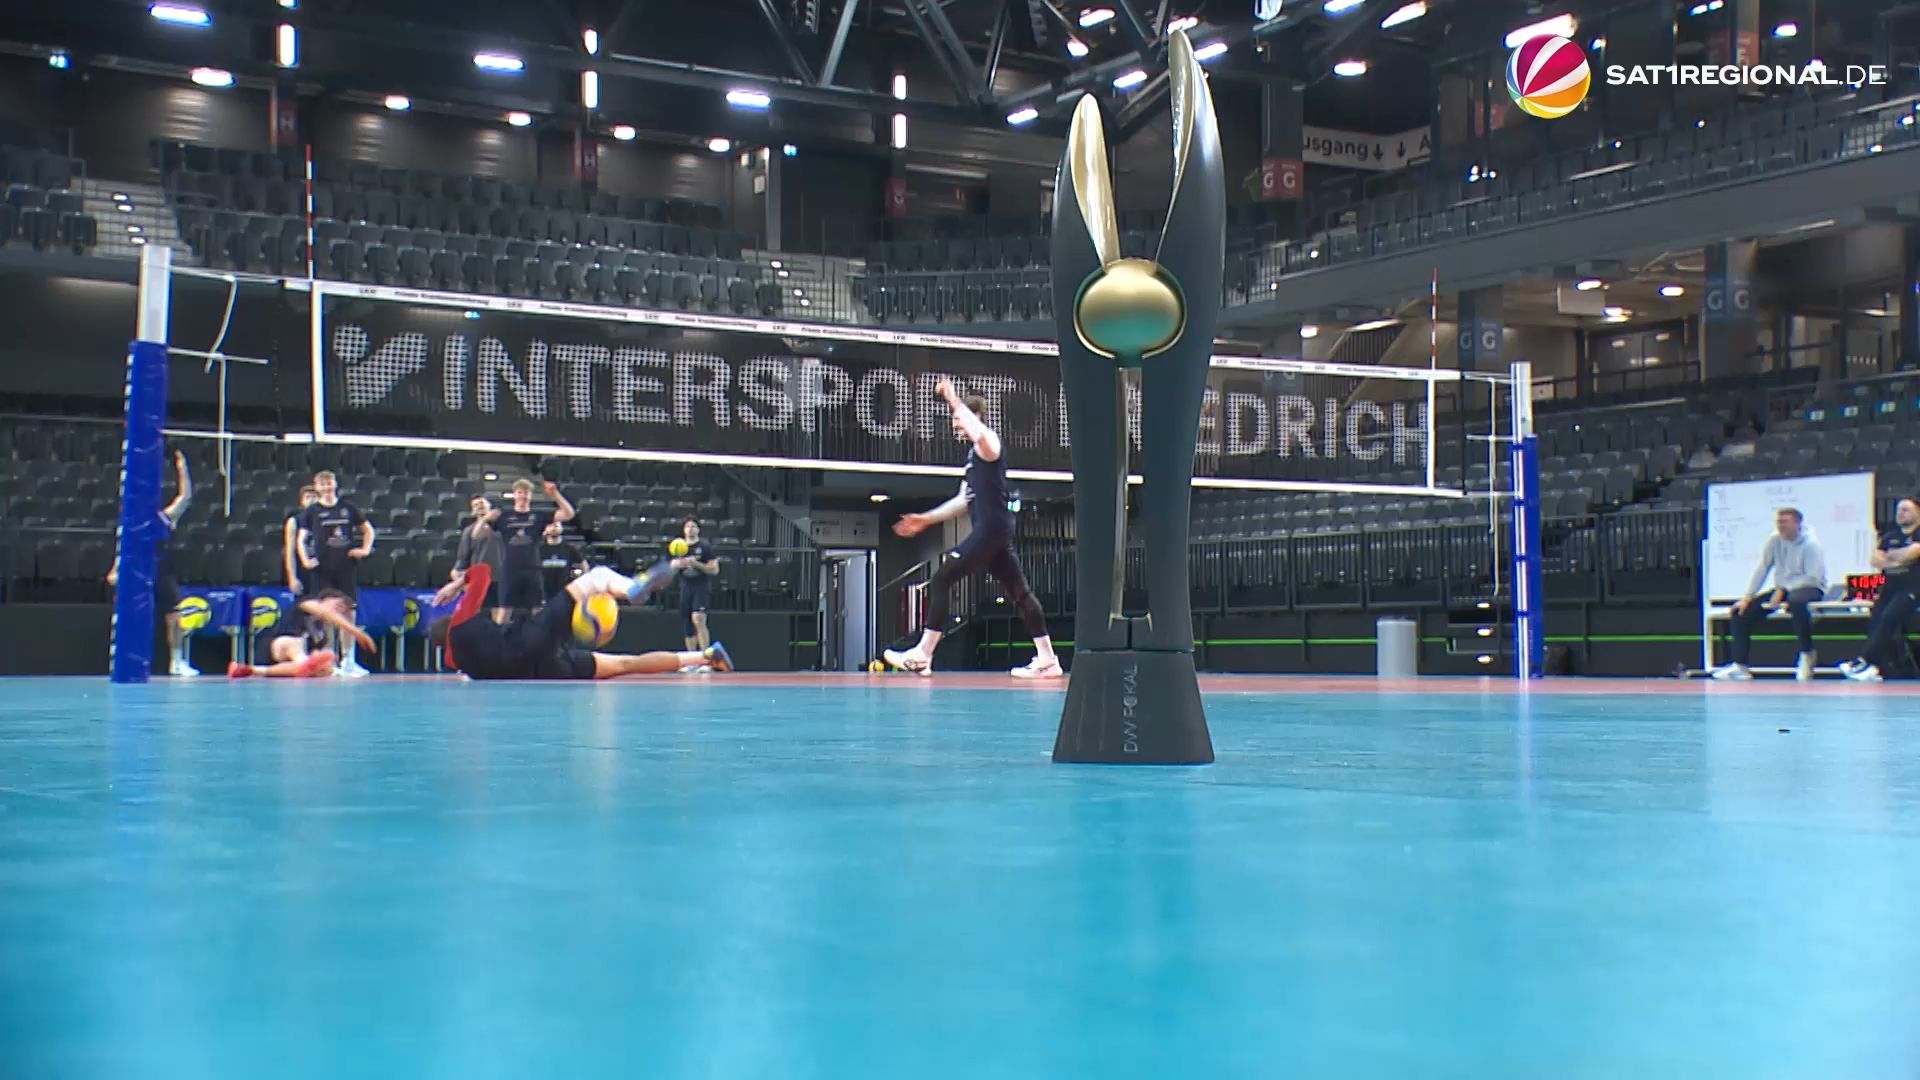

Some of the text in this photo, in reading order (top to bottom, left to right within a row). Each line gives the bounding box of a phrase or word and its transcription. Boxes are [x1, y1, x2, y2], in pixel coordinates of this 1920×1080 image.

[1283, 171, 1296, 189] G
[1707, 289, 1723, 310] G
[1733, 289, 1750, 310] G
[1482, 330, 1496, 350] G
[443, 331, 1018, 446] INTERSPORT
